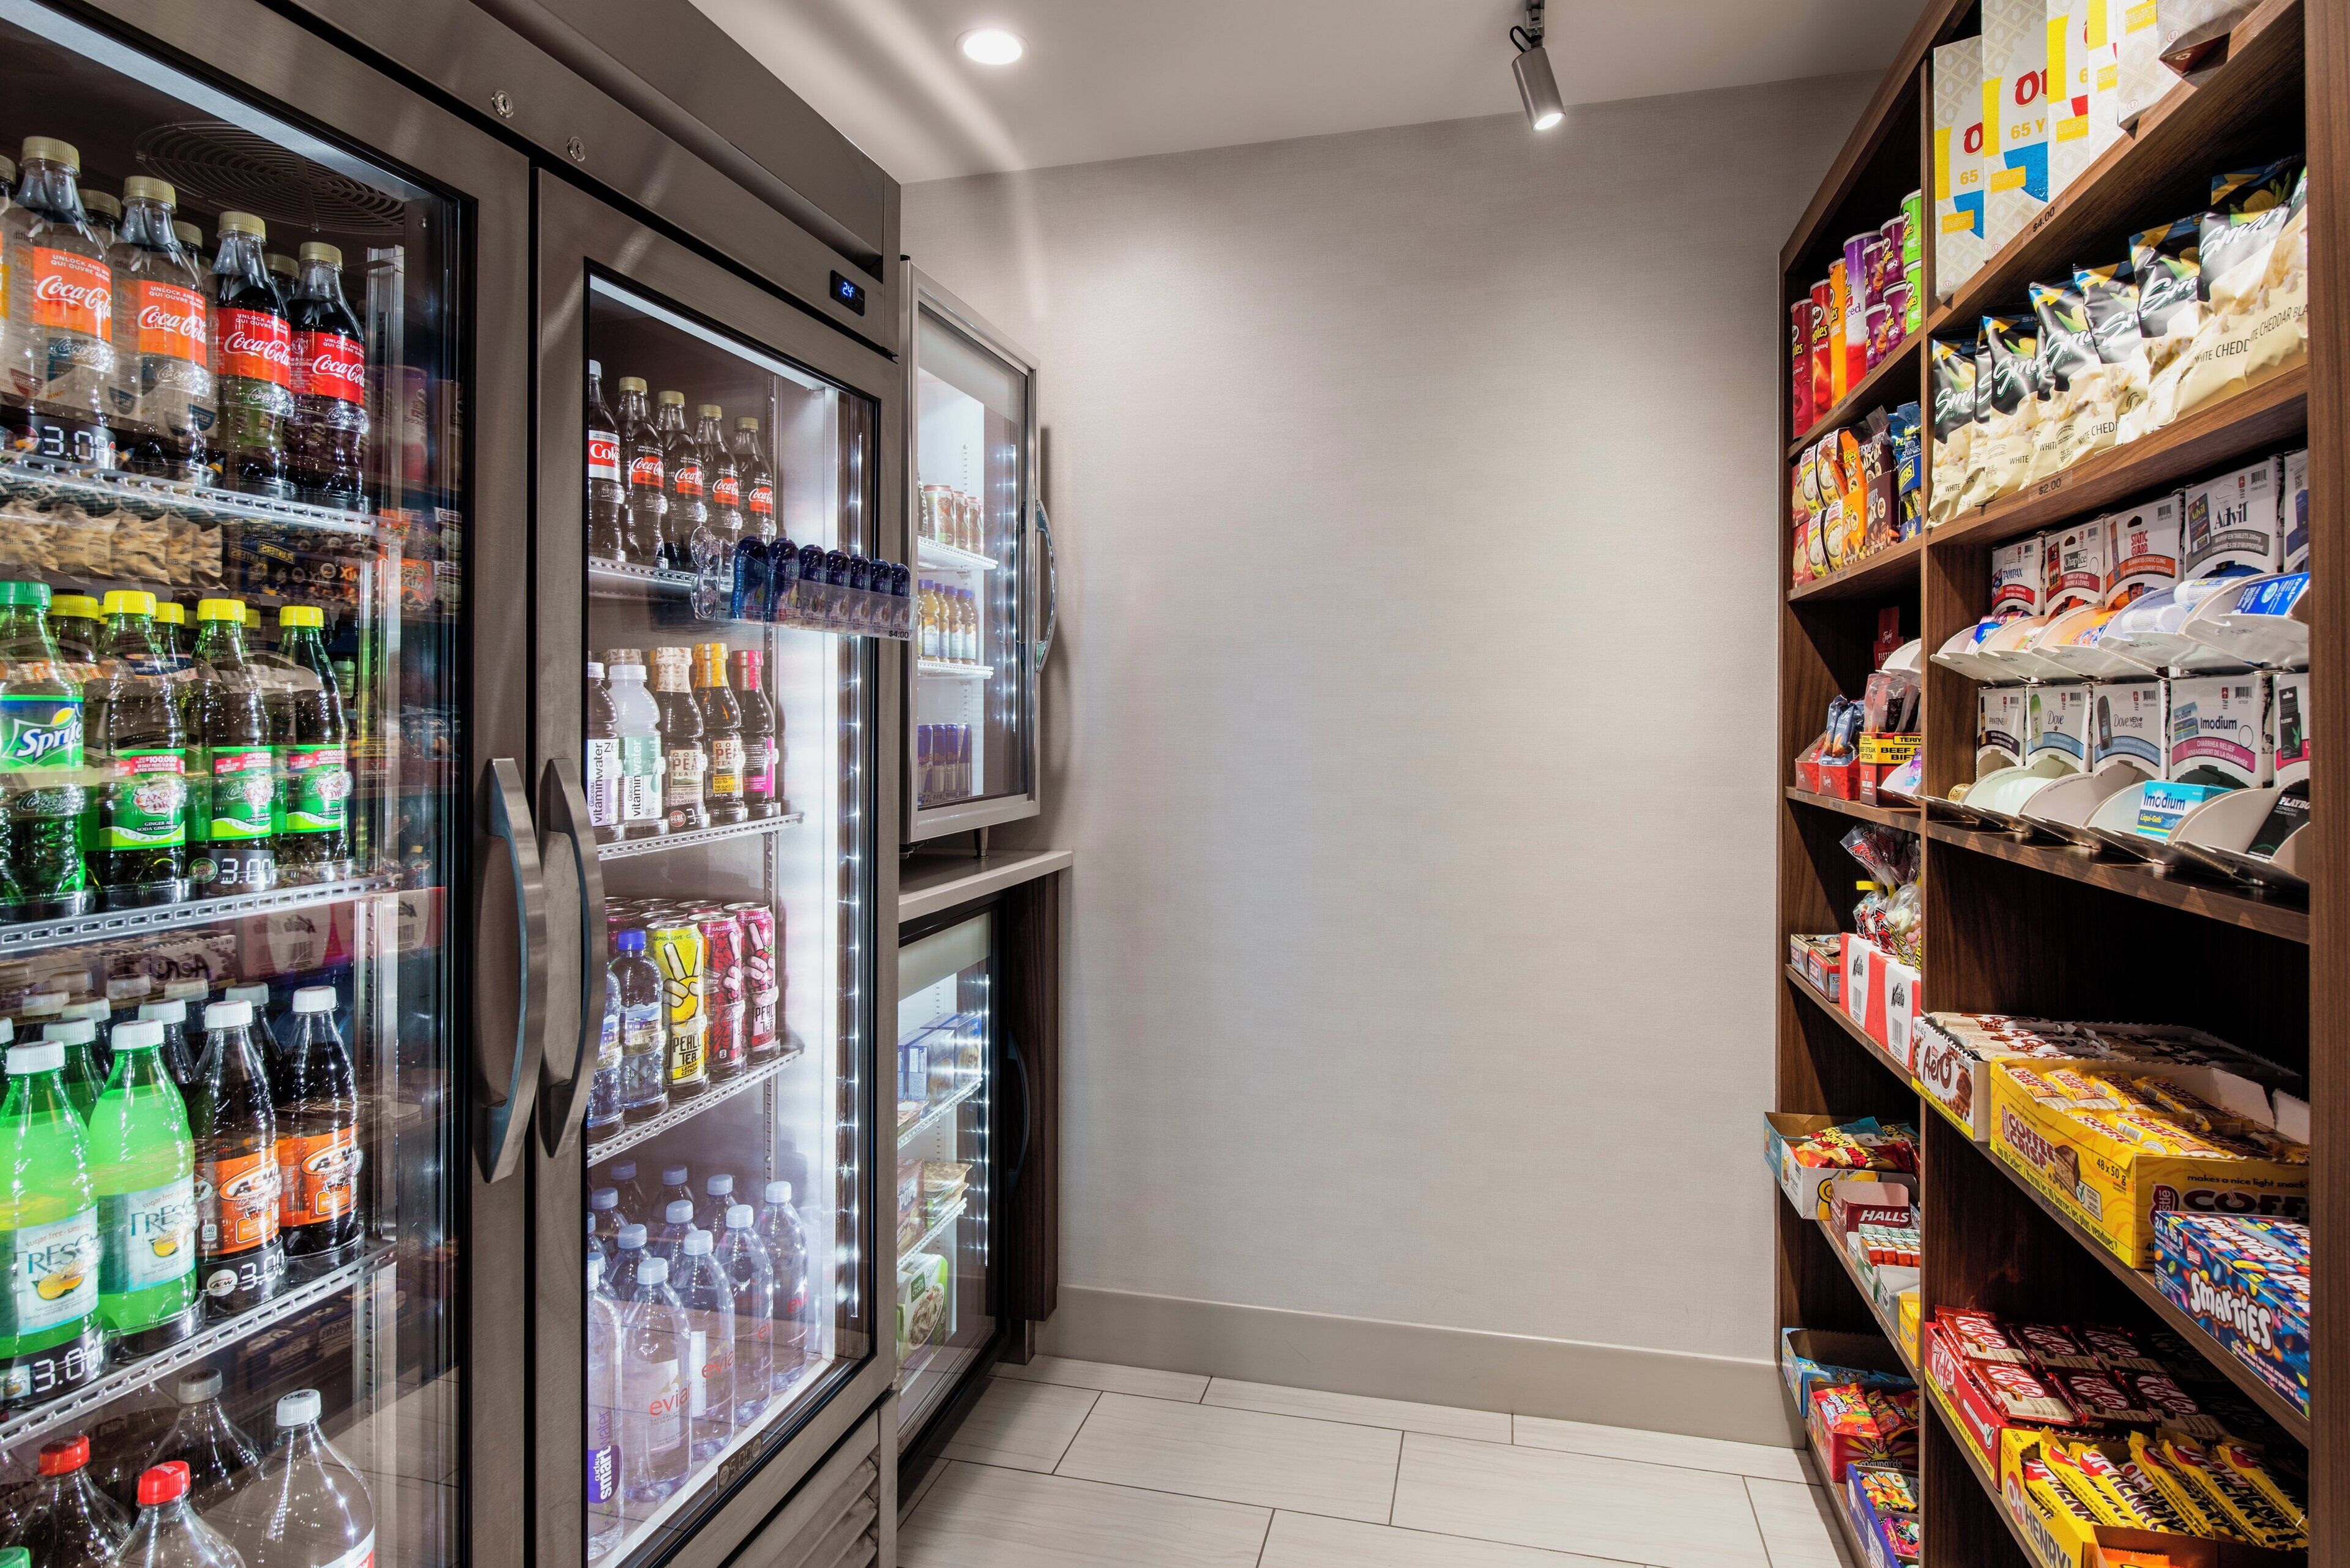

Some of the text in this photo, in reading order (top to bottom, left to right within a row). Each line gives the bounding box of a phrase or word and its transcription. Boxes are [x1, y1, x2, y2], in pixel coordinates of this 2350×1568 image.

[2010, 121, 2031, 140] 65
[1960, 169, 1978, 185] 65
[2032, 206, 2056, 233] $4.00
[53, 254, 101, 273] UNLOCK AND
[69, 263, 94, 276] OUVRE
[36, 275, 111, 319] Coca-Cola
[151, 286, 195, 301] UNLOCK AND
[165, 294, 188, 305] OUVRE
[137, 305, 207, 343] Coca-Cola
[237, 313, 265, 323] UNLOCK
[250, 319, 273, 330] OUVRE
[2259, 307, 2291, 337] CHEDDAR
[224, 330, 291, 366] Coca-Cola
[324, 337, 348, 348] UNLOCK
[338, 344, 354, 354] OUVRE
[589, 443, 620, 462] Coke
[2010, 455, 2029, 466] WHITE
[1945, 484, 1961, 493] WHITE
[2038, 478, 2062, 496] $2.00
[2214, 501, 2248, 531] Advil
[2131, 530, 2148, 547] STATIC
[2131, 543, 2149, 556] GUARD
[2002, 567, 2023, 581] TAMPAX
[889, 630, 909, 640] $4.00
[2048, 710, 2064, 725] Dove
[2113, 714, 2129, 728] Dove
[2174, 709, 2192, 722] Imodium
[2200, 715, 2237, 730] Imodium
[17, 715, 83, 759] Sprite
[2196, 740, 2235, 752] DIARRHEA RELIEF
[594, 742, 603, 824] vitaminwater
[633, 739, 641, 818] vitaminwater
[2143, 792, 2185, 811] Imodium
[2140, 813, 2162, 824] Liqui-Gels
[679, 1048, 697, 1066] TEA
[681, 1061, 698, 1072] LEMON
[681, 1066, 698, 1077] CITRON
[2008, 1111, 2056, 1163] COFFEE
[2009, 1130, 2047, 1171] CRISP
[2096, 1157, 2127, 1187] 48 x 50 g
[2187, 1174, 2220, 1184] makes
[2231, 1176, 2251, 1186] nice
[2253, 1178, 2274, 1189] light
[2277, 1179, 2307, 1189] snack
[1859, 1209, 1910, 1223] HALLS
[2054, 1190, 2071, 1214] barres
[2079, 1214, 2091, 1231] plus
[2155, 1215, 2163, 1233] 24
[2164, 1227, 2169, 1237] x
[2169, 1225, 2179, 1242] 45
[2178, 1236, 2184, 1250] g
[1934, 1350, 1954, 1389] KitKat
[596, 1409, 611, 1448] water
[597, 1445, 613, 1501] smart
[2007, 1476, 2023, 1516] OH
